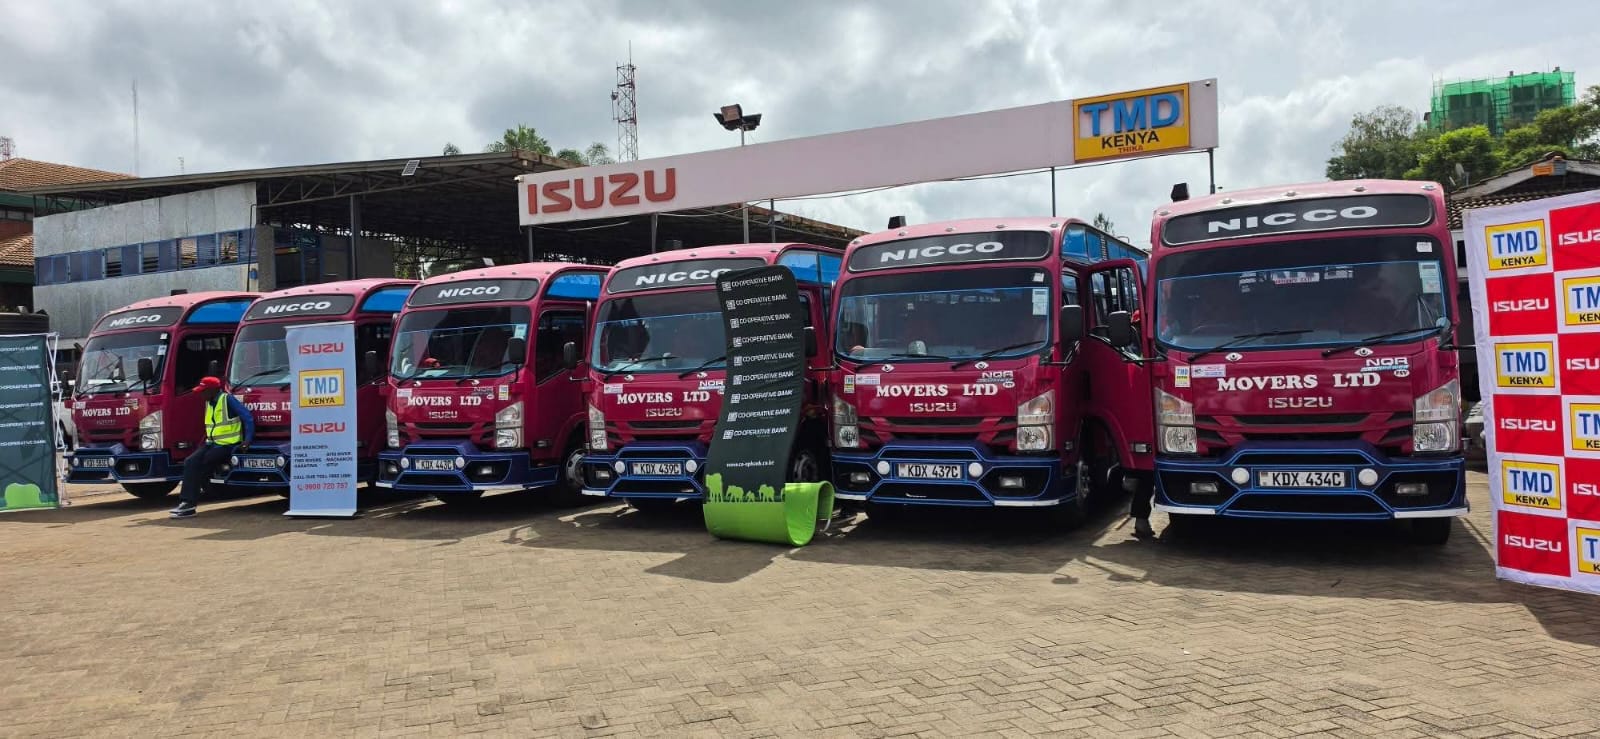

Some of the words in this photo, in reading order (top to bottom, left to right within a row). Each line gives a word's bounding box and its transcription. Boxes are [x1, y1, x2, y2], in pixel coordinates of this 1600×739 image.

[1083, 94, 1180, 136] TMD
[1101, 131, 1159, 149] KENYA
[1118, 145, 1144, 153] THIKA
[527, 168, 676, 214] ISUZU
[1208, 206, 1378, 233] NICCO
[1493, 230, 1538, 254] TMD
[1558, 229, 1600, 246] ISUZ
[880, 241, 1004, 262] NICCO
[1501, 256, 1536, 267] KENYA
[768, 274, 784, 282] BANK
[437, 286, 501, 298] NICCO
[771, 293, 788, 301] BANK
[1572, 286, 1600, 309] TM
[264, 301, 331, 314] NICCO
[1494, 298, 1549, 313] ISUZU
[110, 314, 161, 327] NICCO
[1579, 313, 1600, 322] KEN
[777, 332, 793, 340] BANK
[299, 342, 344, 354] ISUZU
[1366, 357, 1408, 366] NQR
[1503, 351, 1546, 373] TMD
[1566, 358, 1600, 370] ISU
[778, 370, 794, 378] BANK
[982, 370, 1013, 378] NQR
[1509, 375, 1544, 385] KENYA
[304, 377, 338, 395] TMD
[1217, 374, 1318, 391] MOVERS
[1333, 372, 1381, 387] LTD
[777, 389, 793, 397] BANK
[876, 385, 948, 397] MOVERS
[963, 384, 998, 396] LTD
[309, 397, 335, 405] KENYA
[407, 396, 452, 406] MOVERS
[460, 395, 482, 406] LTD
[617, 392, 673, 404] MOVERS
[683, 391, 710, 402] LTD
[1268, 396, 1332, 408] ISUZU
[82, 407, 112, 417] MOVERS
[115, 406, 131, 415] LTD
[245, 402, 277, 411] OVERS
[281, 401, 292, 411] LT
[775, 408, 791, 416] BANK
[910, 402, 957, 412] ISUZU
[646, 408, 682, 417] ISUZU
[299, 422, 345, 434] ISUZU
[771, 426, 788, 434] BANK
[1501, 418, 1556, 432] ISUZU
[640, 463, 656, 474] KDX
[659, 463, 679, 475] 439C
[908, 464, 928, 477] KDX
[932, 465, 958, 478] 437C
[1272, 472, 1299, 486] KDX
[1306, 472, 1342, 487] 434C
[1510, 469, 1553, 494] TMD
[1573, 482, 1600, 496] ISU
[1516, 495, 1550, 506] KENYA
[1505, 534, 1561, 553] ISUZU
